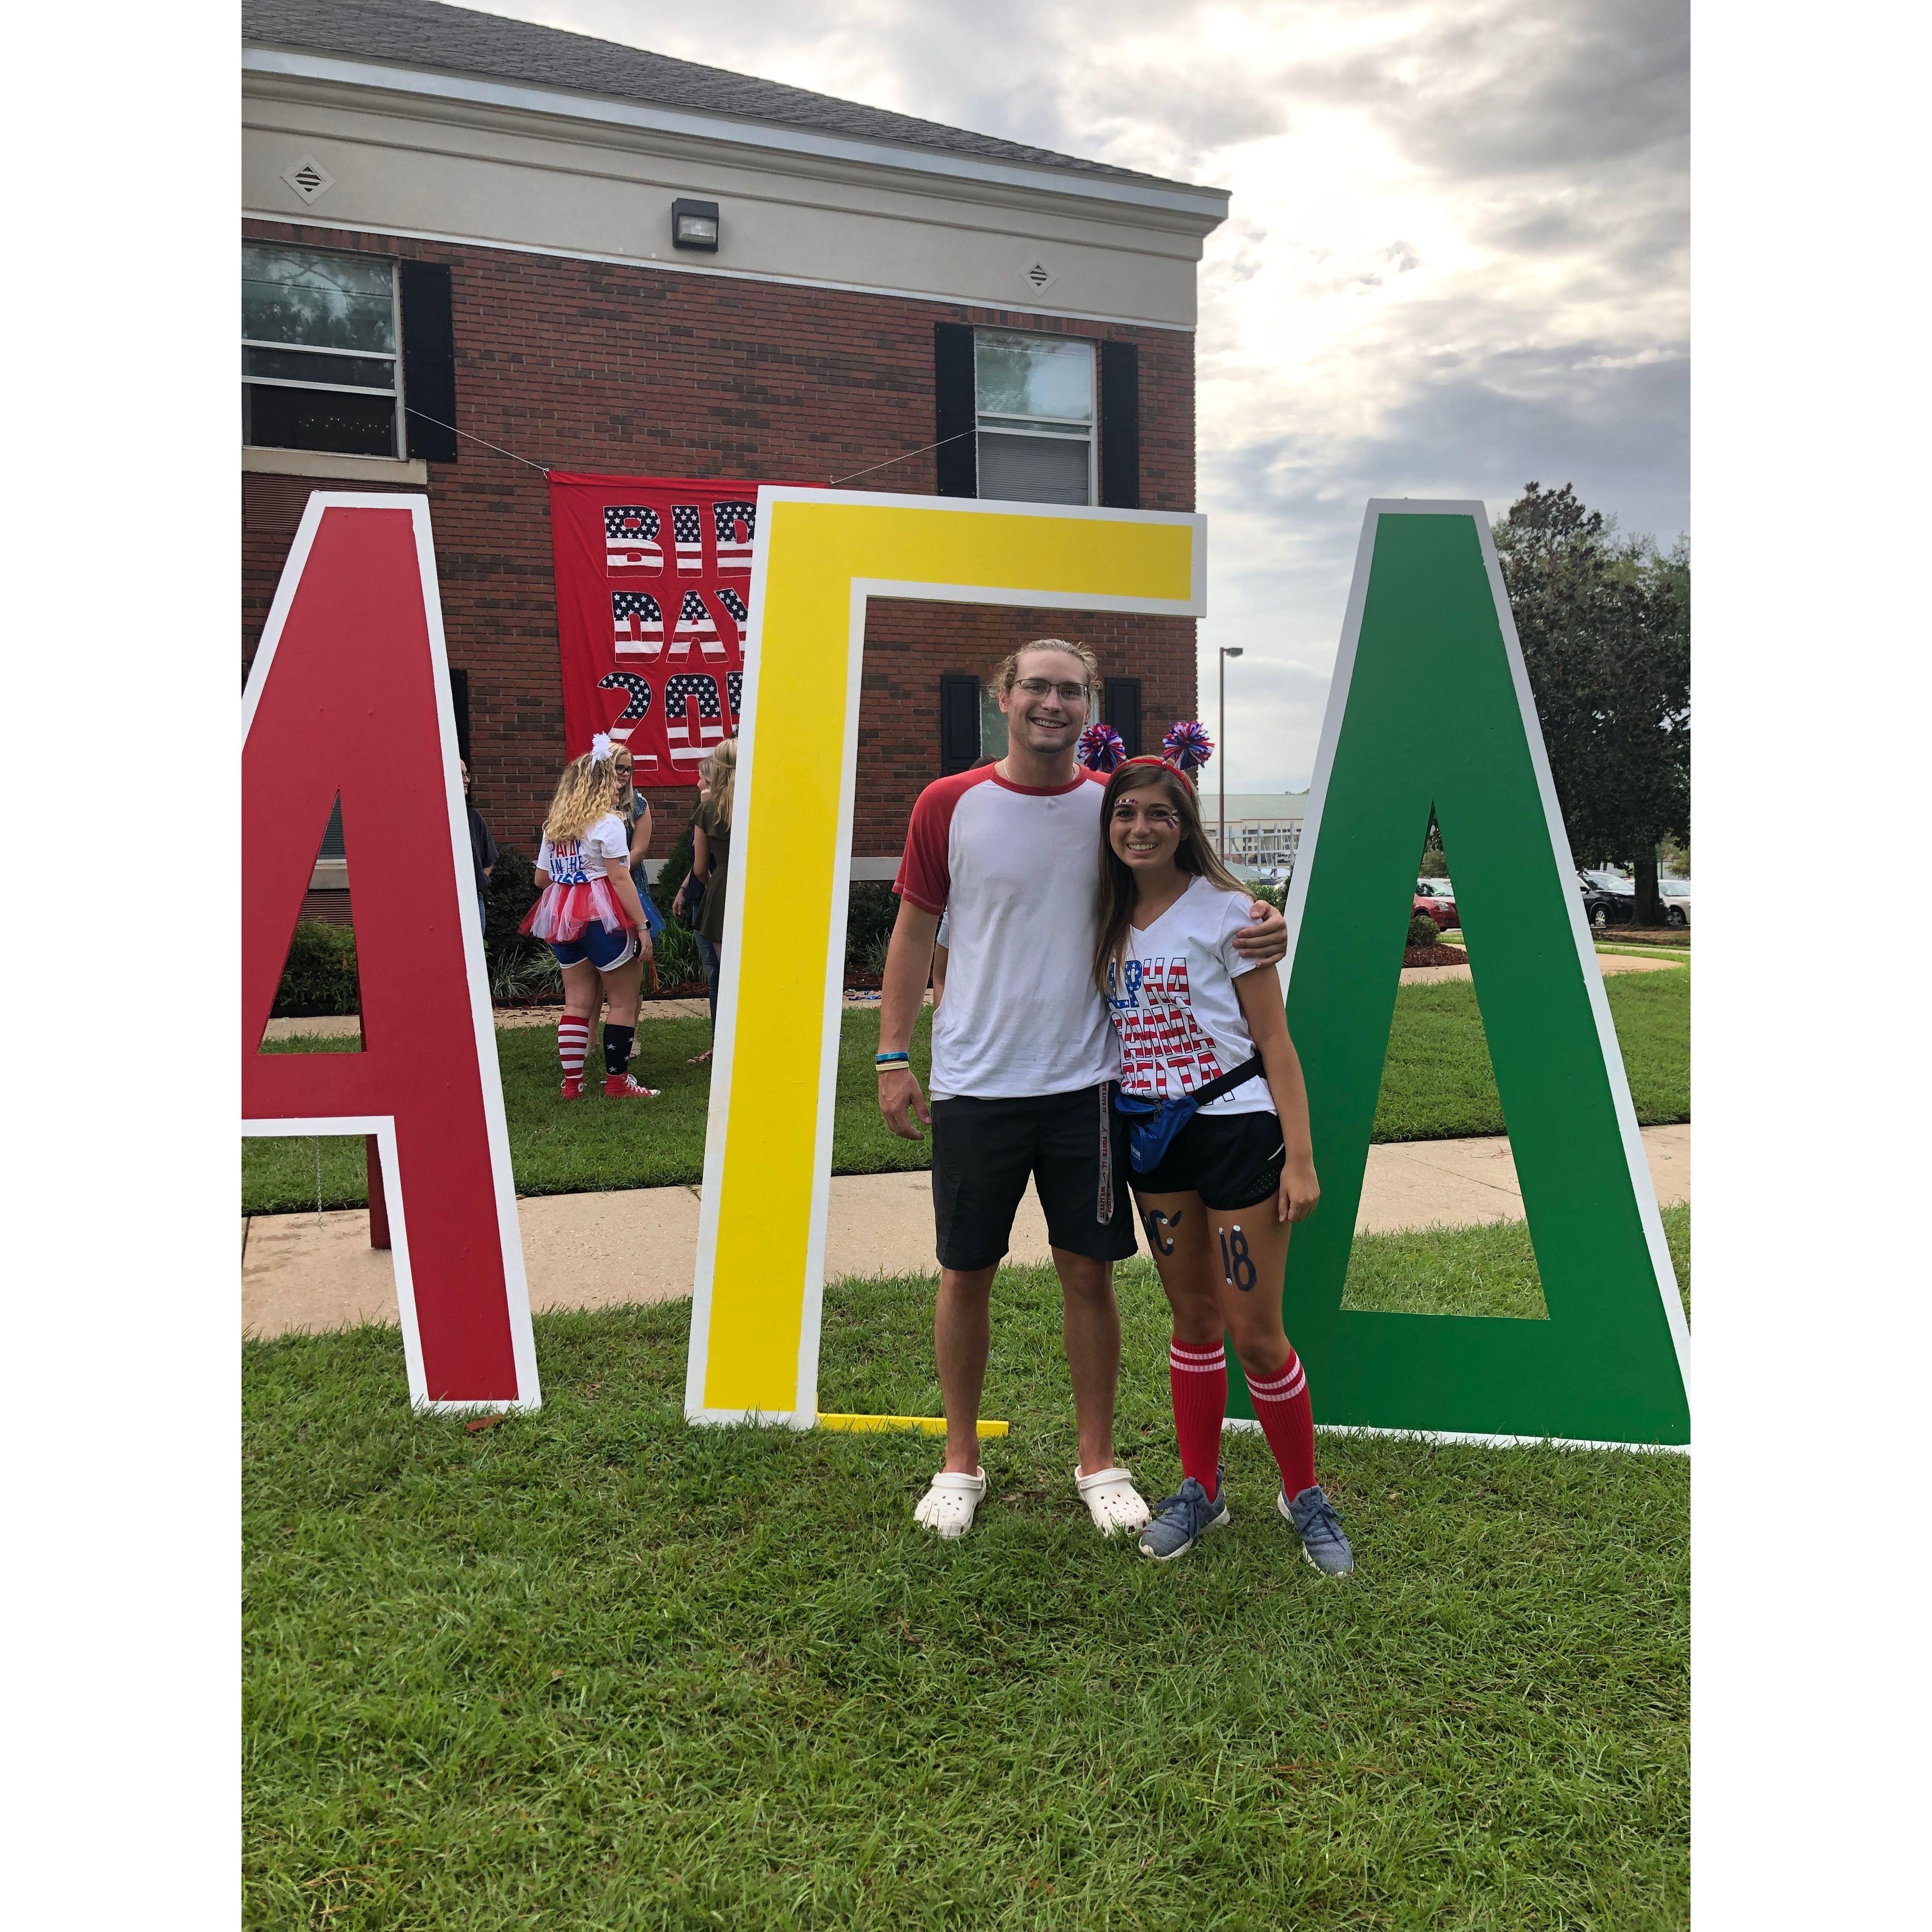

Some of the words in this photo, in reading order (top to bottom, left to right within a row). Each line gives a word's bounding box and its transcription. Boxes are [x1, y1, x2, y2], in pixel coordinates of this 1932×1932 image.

[550, 859, 564, 874] IN
[565, 855, 584, 873] THE
[1101, 1186, 1105, 1196] WE
